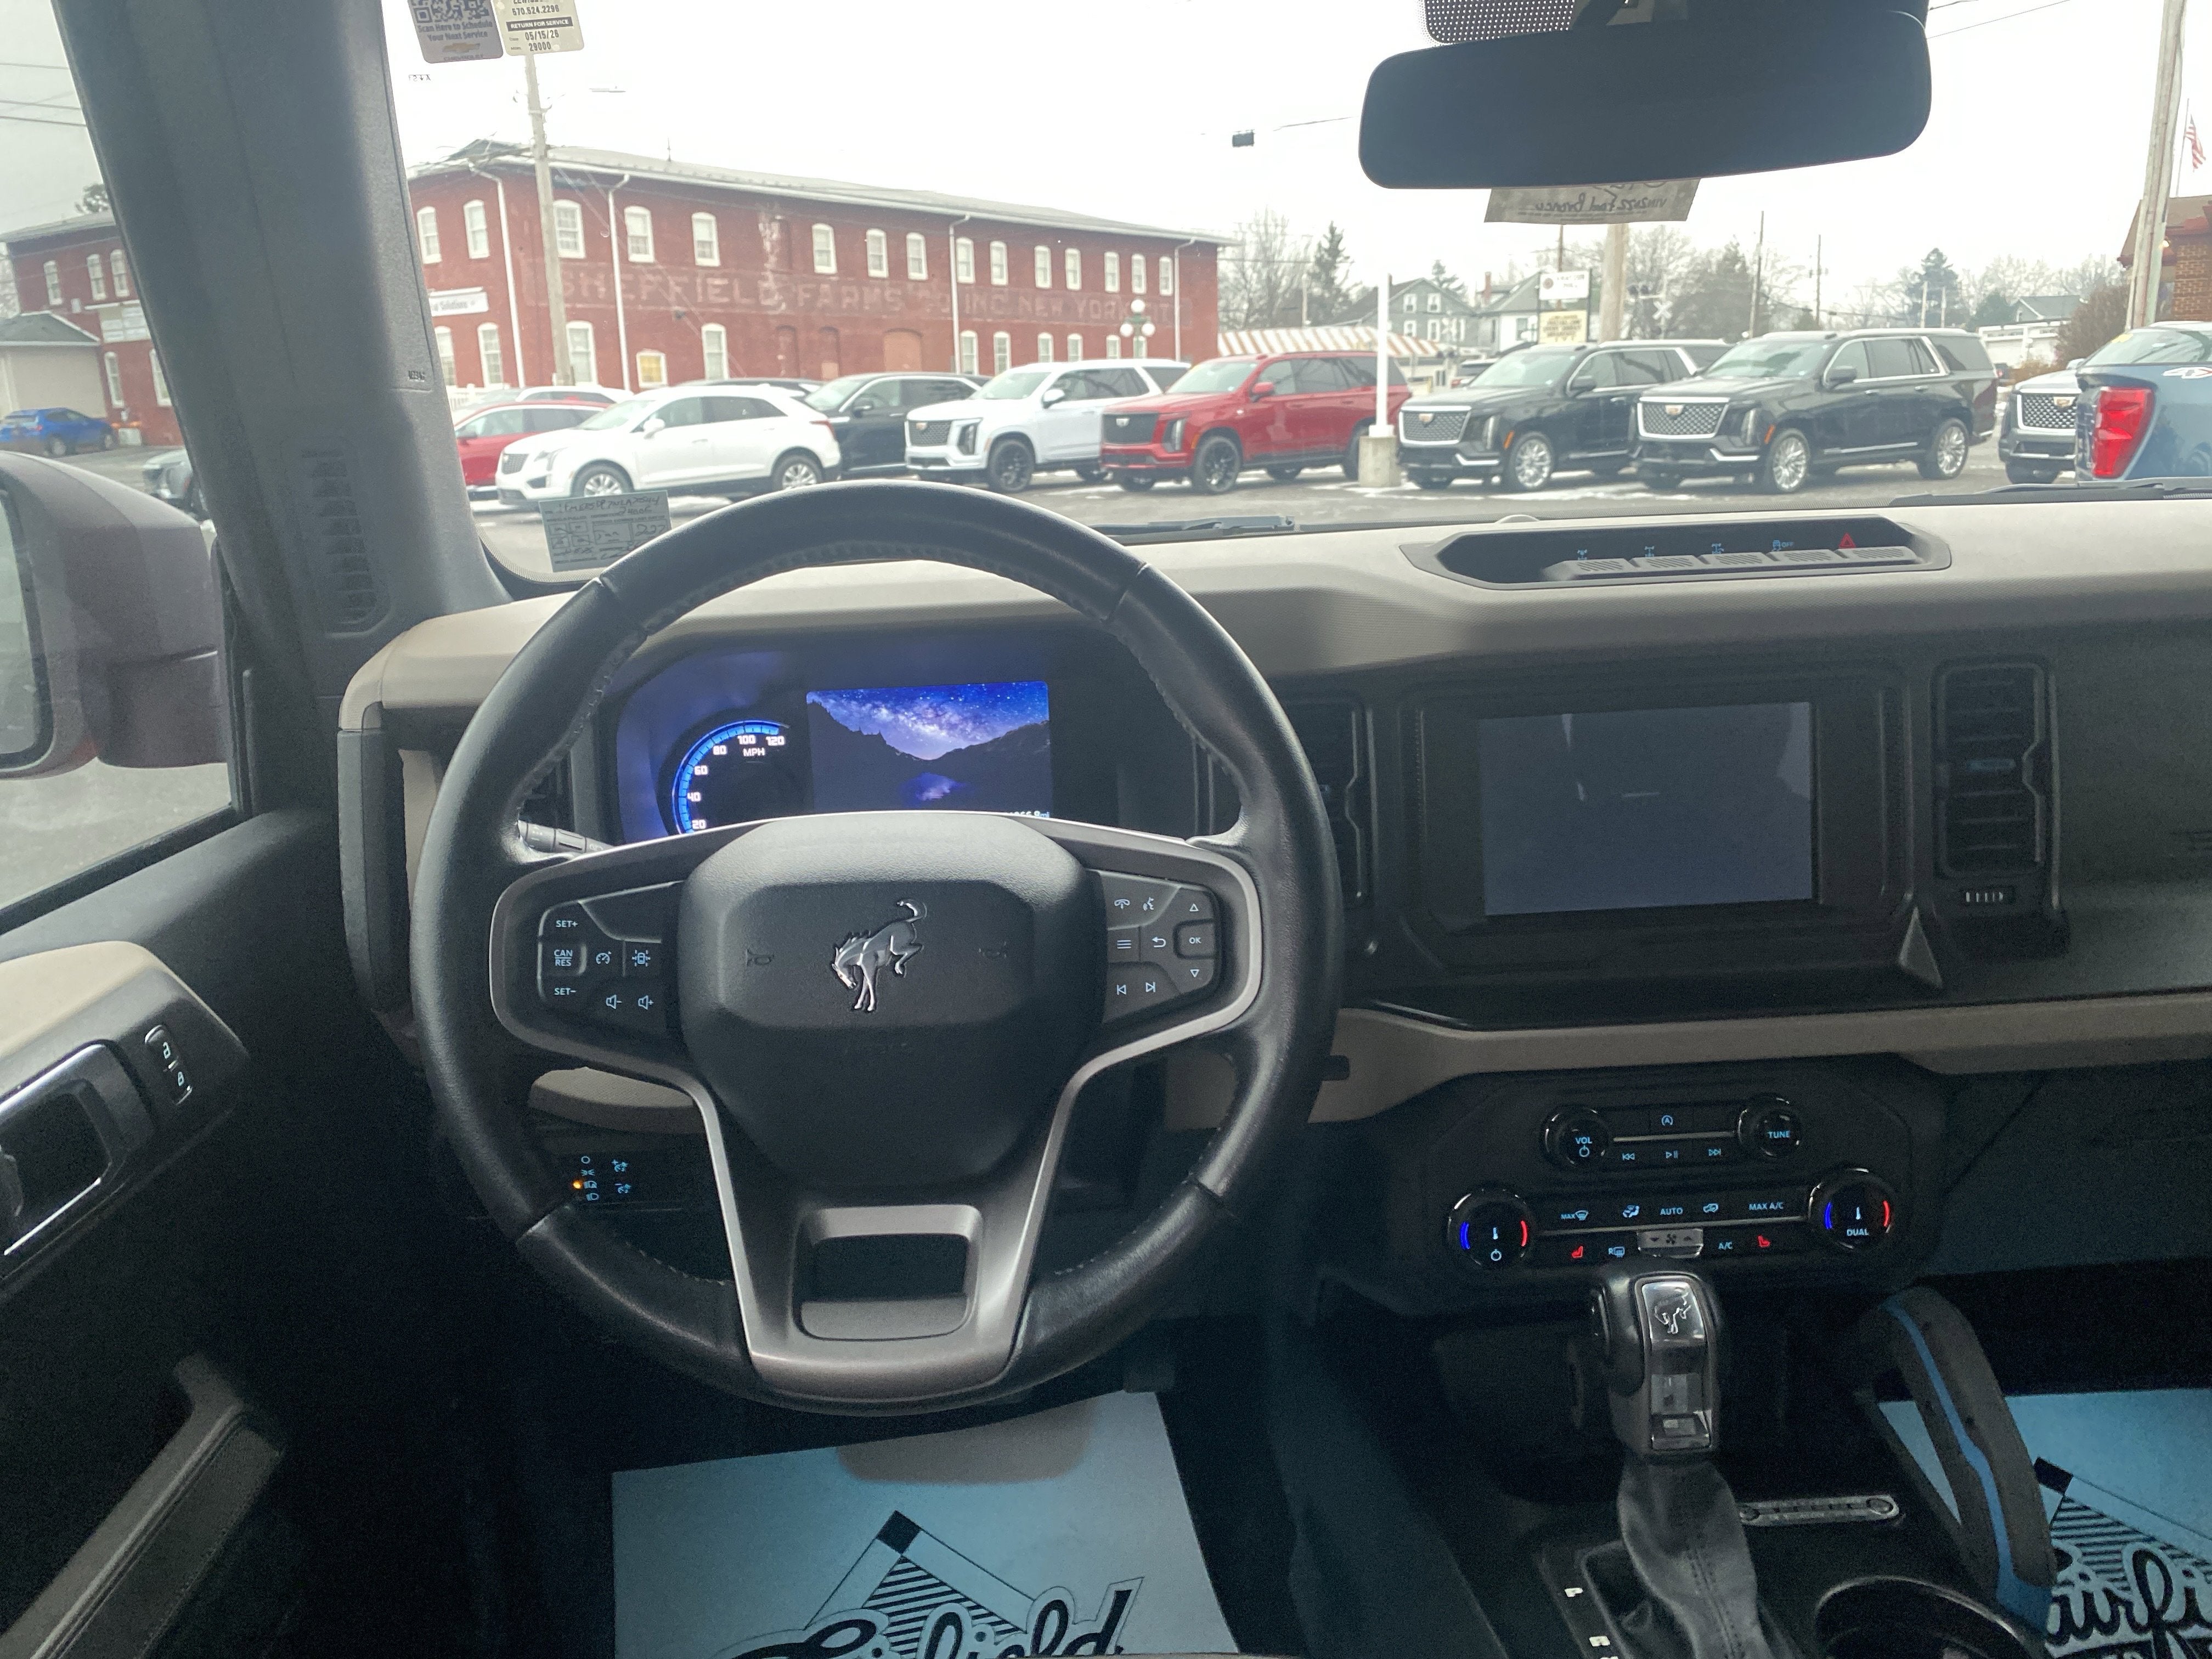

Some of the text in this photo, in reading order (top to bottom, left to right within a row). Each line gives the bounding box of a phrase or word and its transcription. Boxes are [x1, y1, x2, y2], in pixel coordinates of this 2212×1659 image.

[462, 20, 493, 29] Schedule
[463, 31, 488, 40] Service
[528, 41, 551, 52] 29000
[737, 735, 756, 745] 100
[766, 736, 785, 746] 120
[713, 746, 727, 755] 80
[743, 747, 765, 757] MPH
[694, 765, 708, 775] 60
[687, 792, 701, 802] 40
[692, 820, 706, 830] 20
[1767, 1131, 1791, 1139] TUNE
[1749, 1201, 1784, 1211] MAX A/C
[1847, 1228, 1870, 1236] DUAL
[1718, 1242, 1733, 1250] A/C
[1564, 1587, 1583, 1597] P
